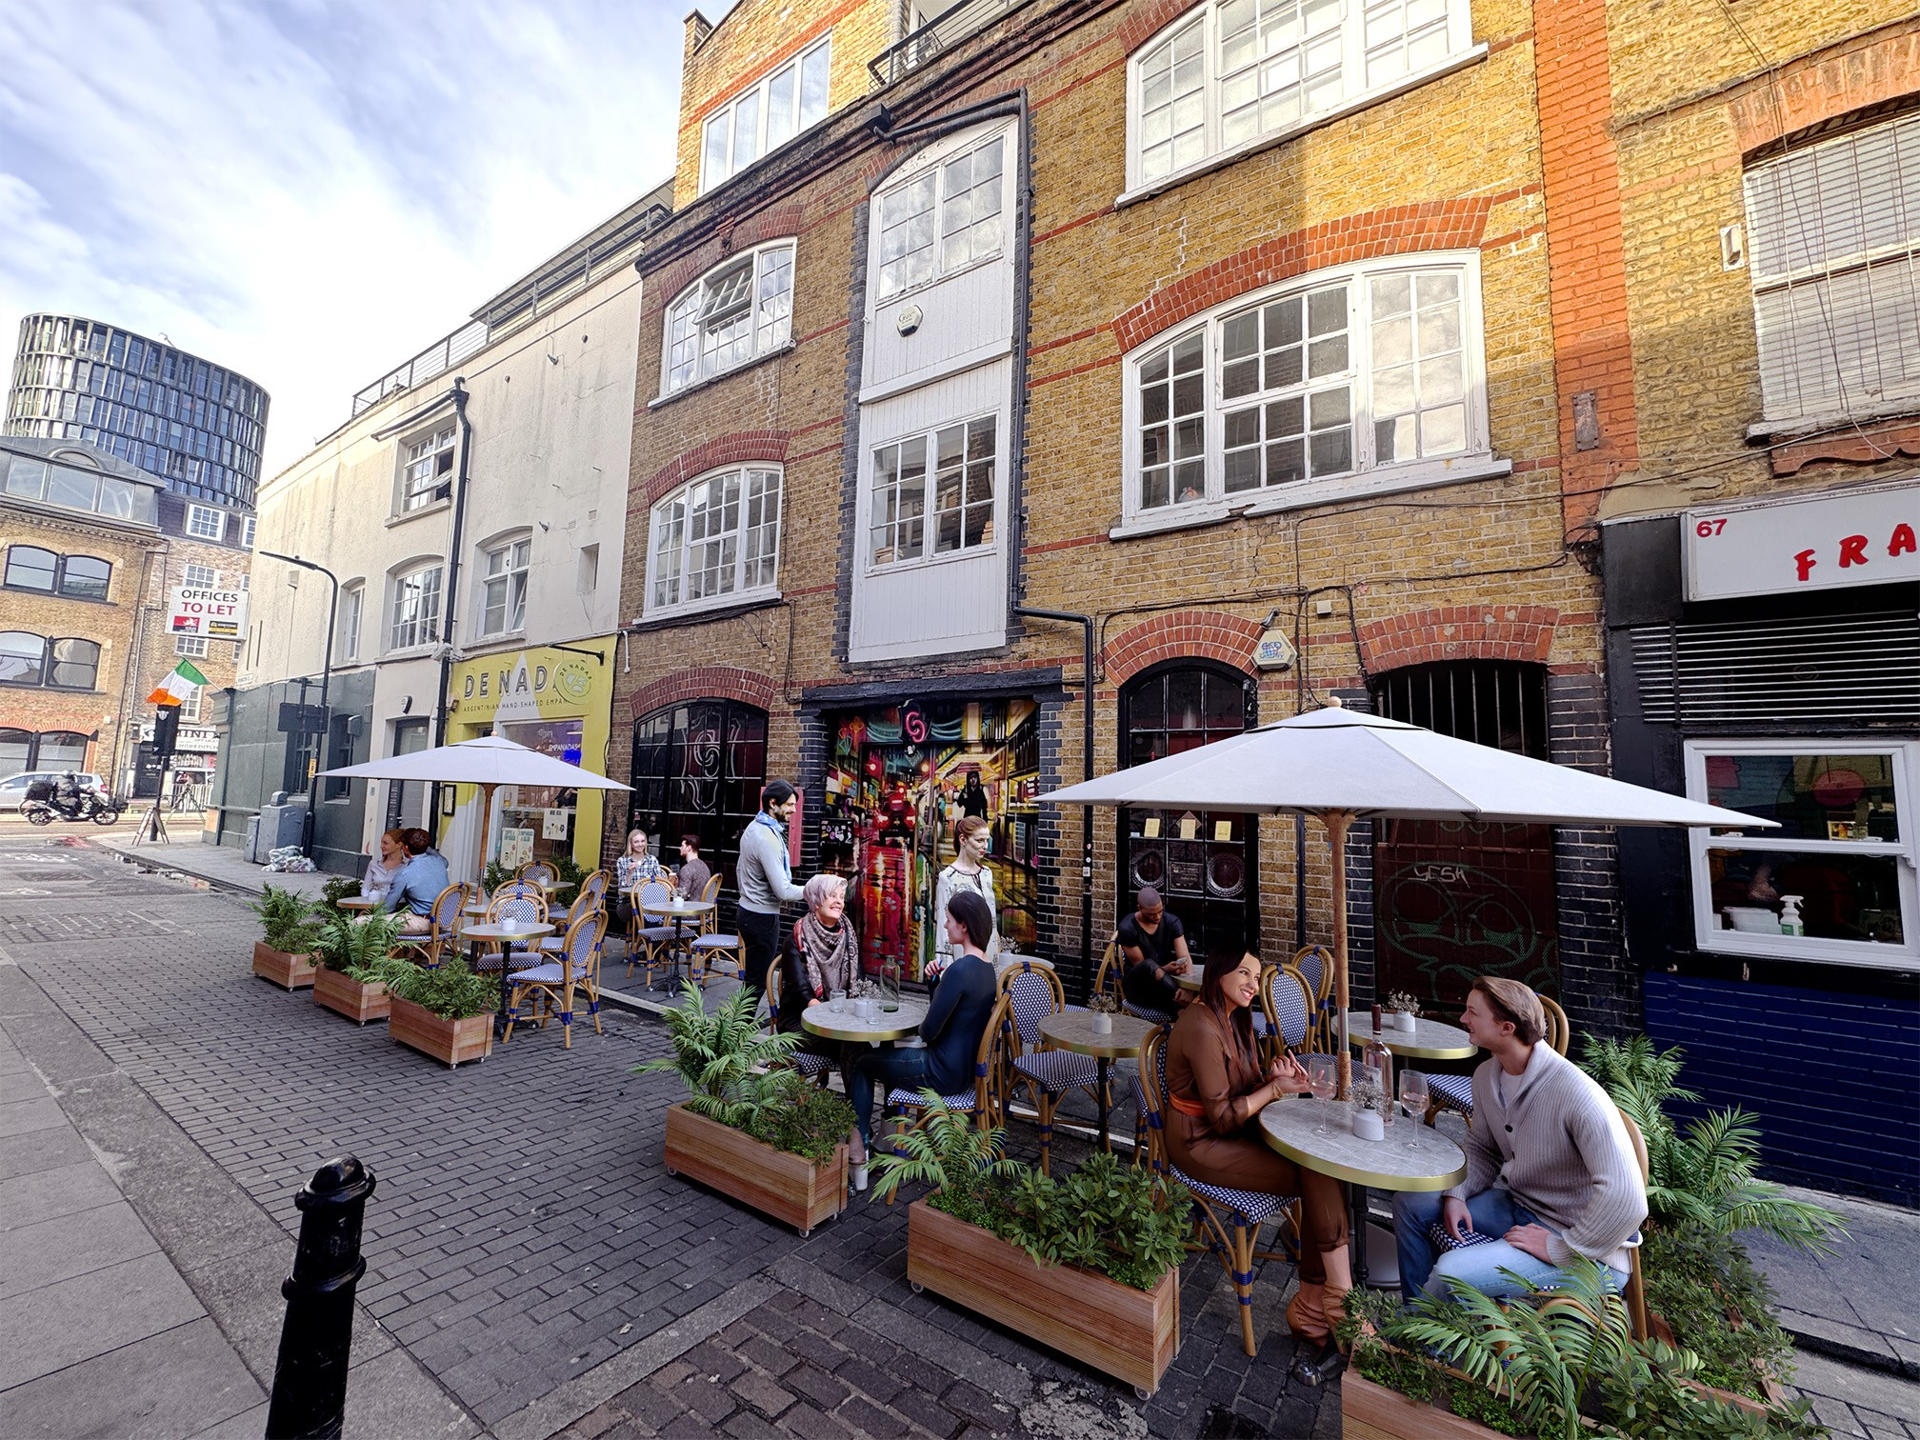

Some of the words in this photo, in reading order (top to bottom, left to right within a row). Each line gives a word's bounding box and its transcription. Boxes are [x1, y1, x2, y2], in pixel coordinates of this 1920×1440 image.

[1696, 518, 1727, 538] 67
[1793, 523, 1917, 581] FRA
[181, 589, 238, 602] OFFICES
[181, 602, 203, 613] TO
[207, 604, 236, 615] LET
[464, 672, 489, 699] DE
[499, 665, 556, 697] NAD
